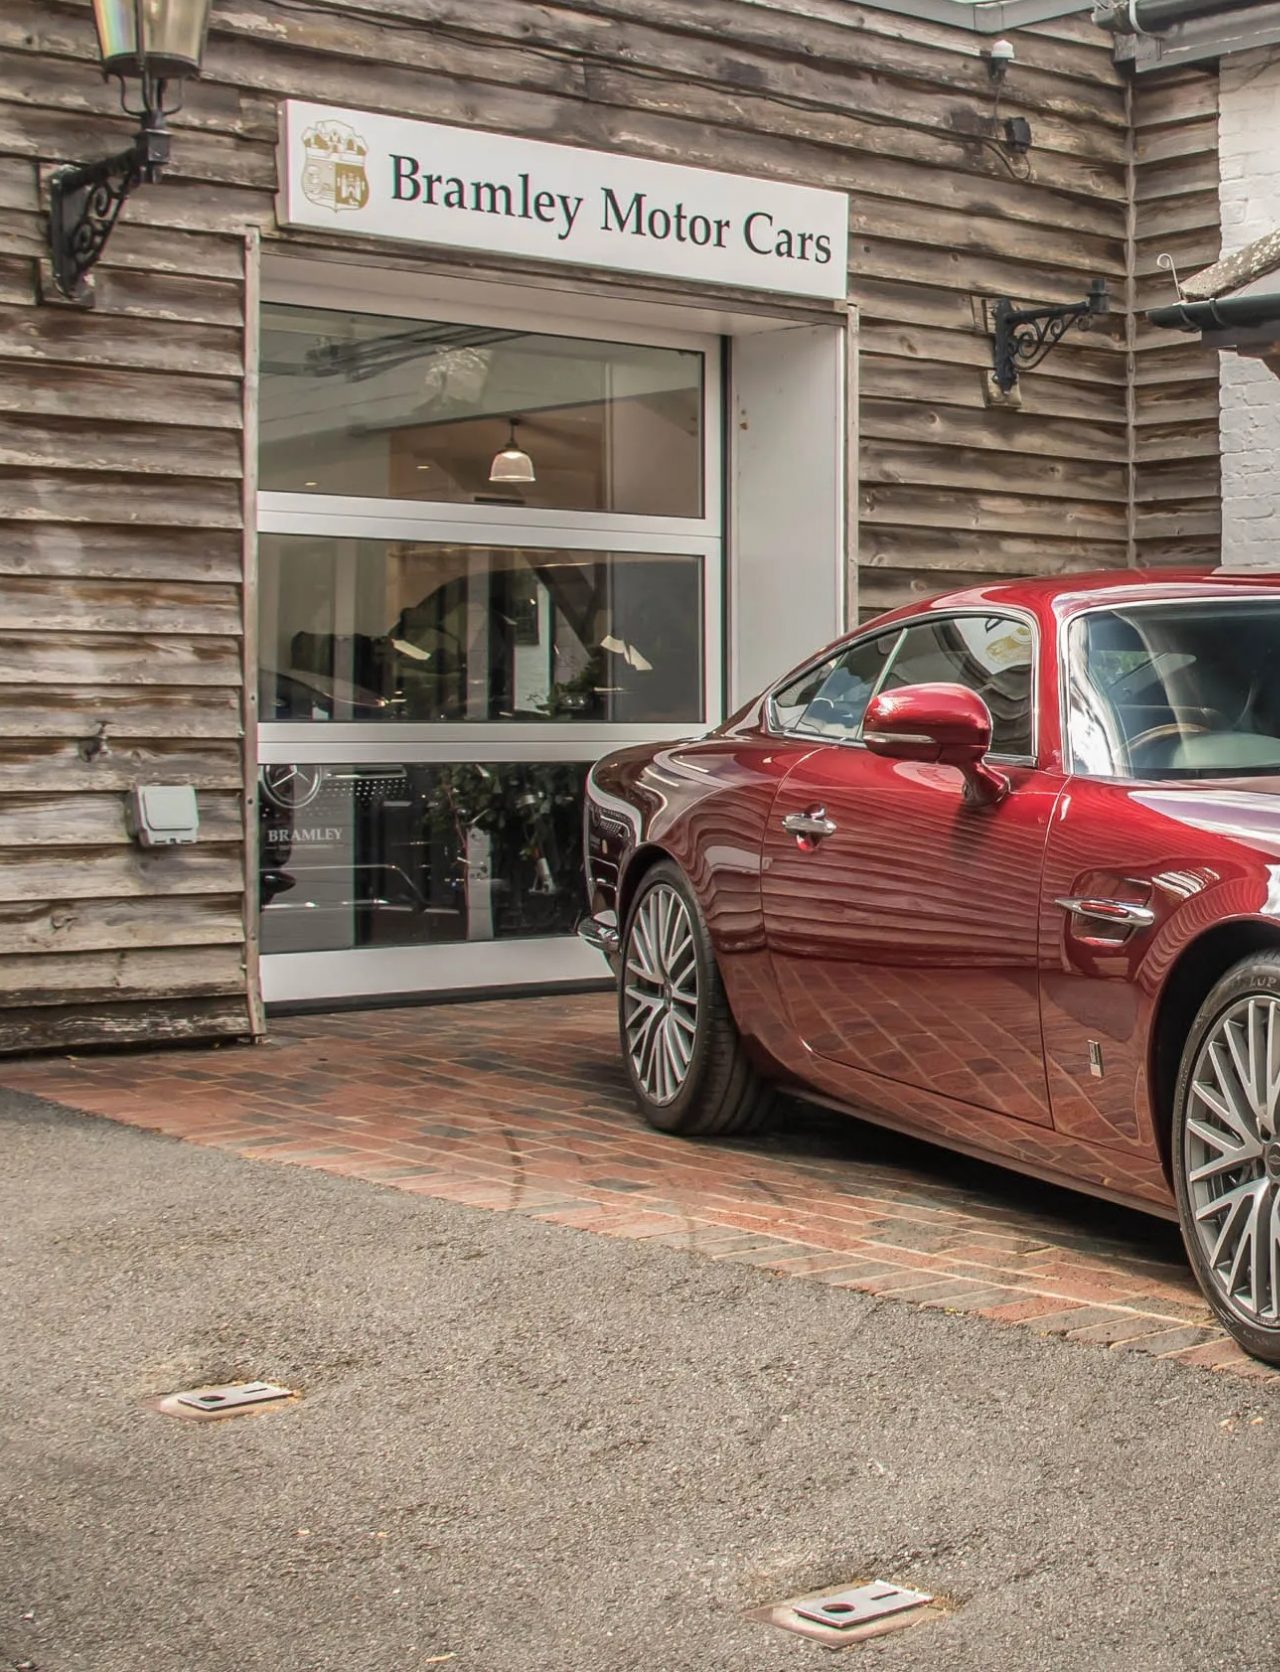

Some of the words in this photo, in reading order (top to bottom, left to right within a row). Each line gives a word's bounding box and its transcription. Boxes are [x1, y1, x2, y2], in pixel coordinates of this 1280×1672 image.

[388, 153, 583, 240] Bramley
[600, 187, 730, 249] Motor
[743, 211, 833, 264] Cars
[268, 828, 343, 842] BRAMLEY
